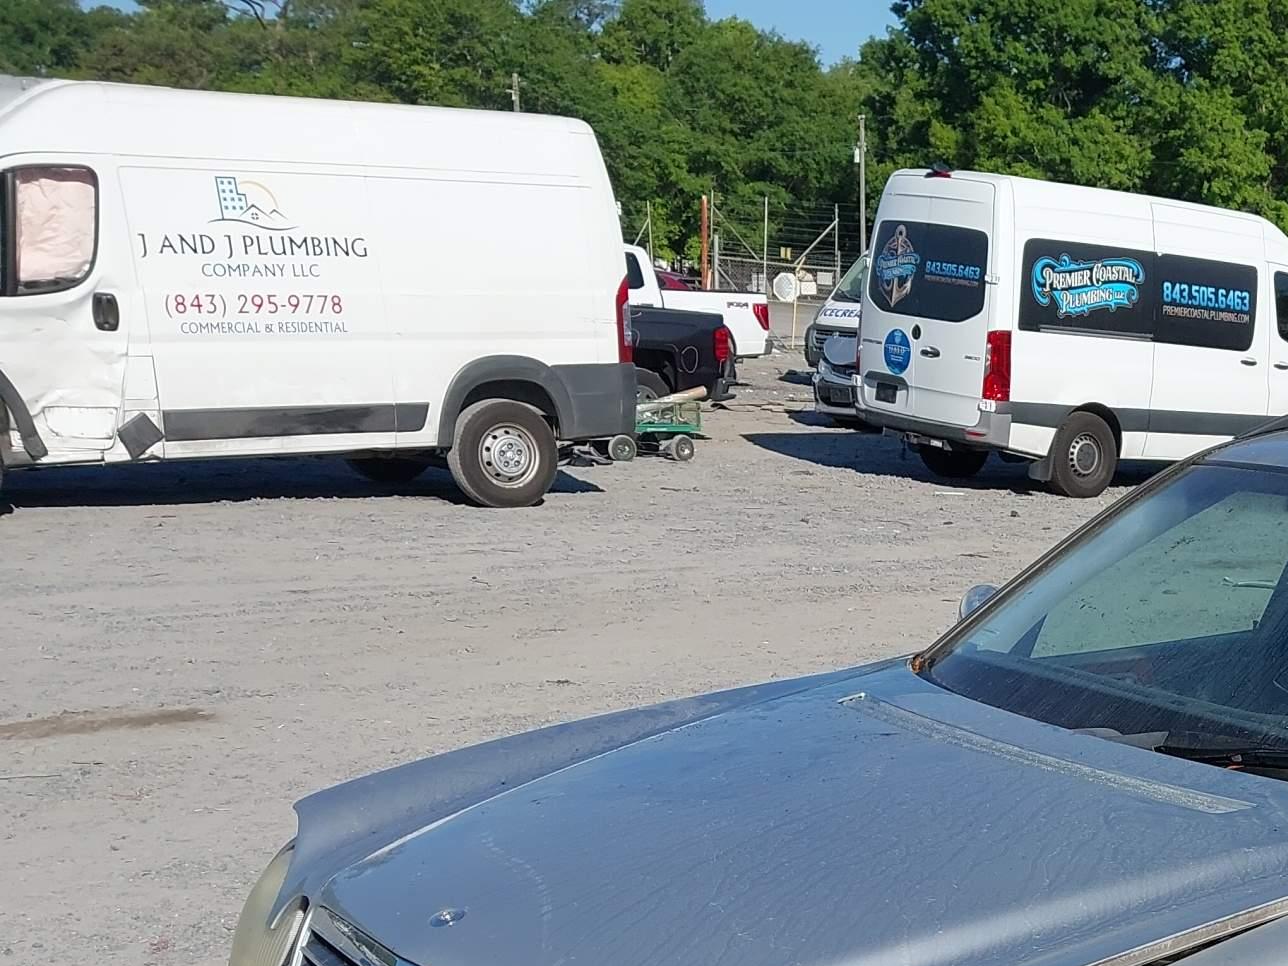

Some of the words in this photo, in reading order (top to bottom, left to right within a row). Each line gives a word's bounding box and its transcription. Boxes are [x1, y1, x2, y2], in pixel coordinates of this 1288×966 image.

[137, 233, 148, 258] J
[159, 234, 216, 255] AND
[223, 235, 233, 259] J
[242, 235, 368, 258] PLUMBING
[201, 263, 286, 278] COMPANY
[292, 264, 320, 278] LLC
[926, 260, 980, 279] 843.505.6463
[1043, 266, 1091, 291] PREMIER
[1092, 263, 1136, 285] COASTAL
[165, 294, 227, 318] (843)
[237, 294, 343, 314] 295-9778
[1060, 289, 1113, 313] PLUMBING
[1162, 281, 1250, 312] 843.505.6463
[1162, 304, 1250, 324] PREMIERCOASTALPLUMBING.COM
[180, 322, 261, 334] COMMERCIAL
[264, 323, 273, 333] &
[278, 322, 348, 334] RESIDENTIAL
